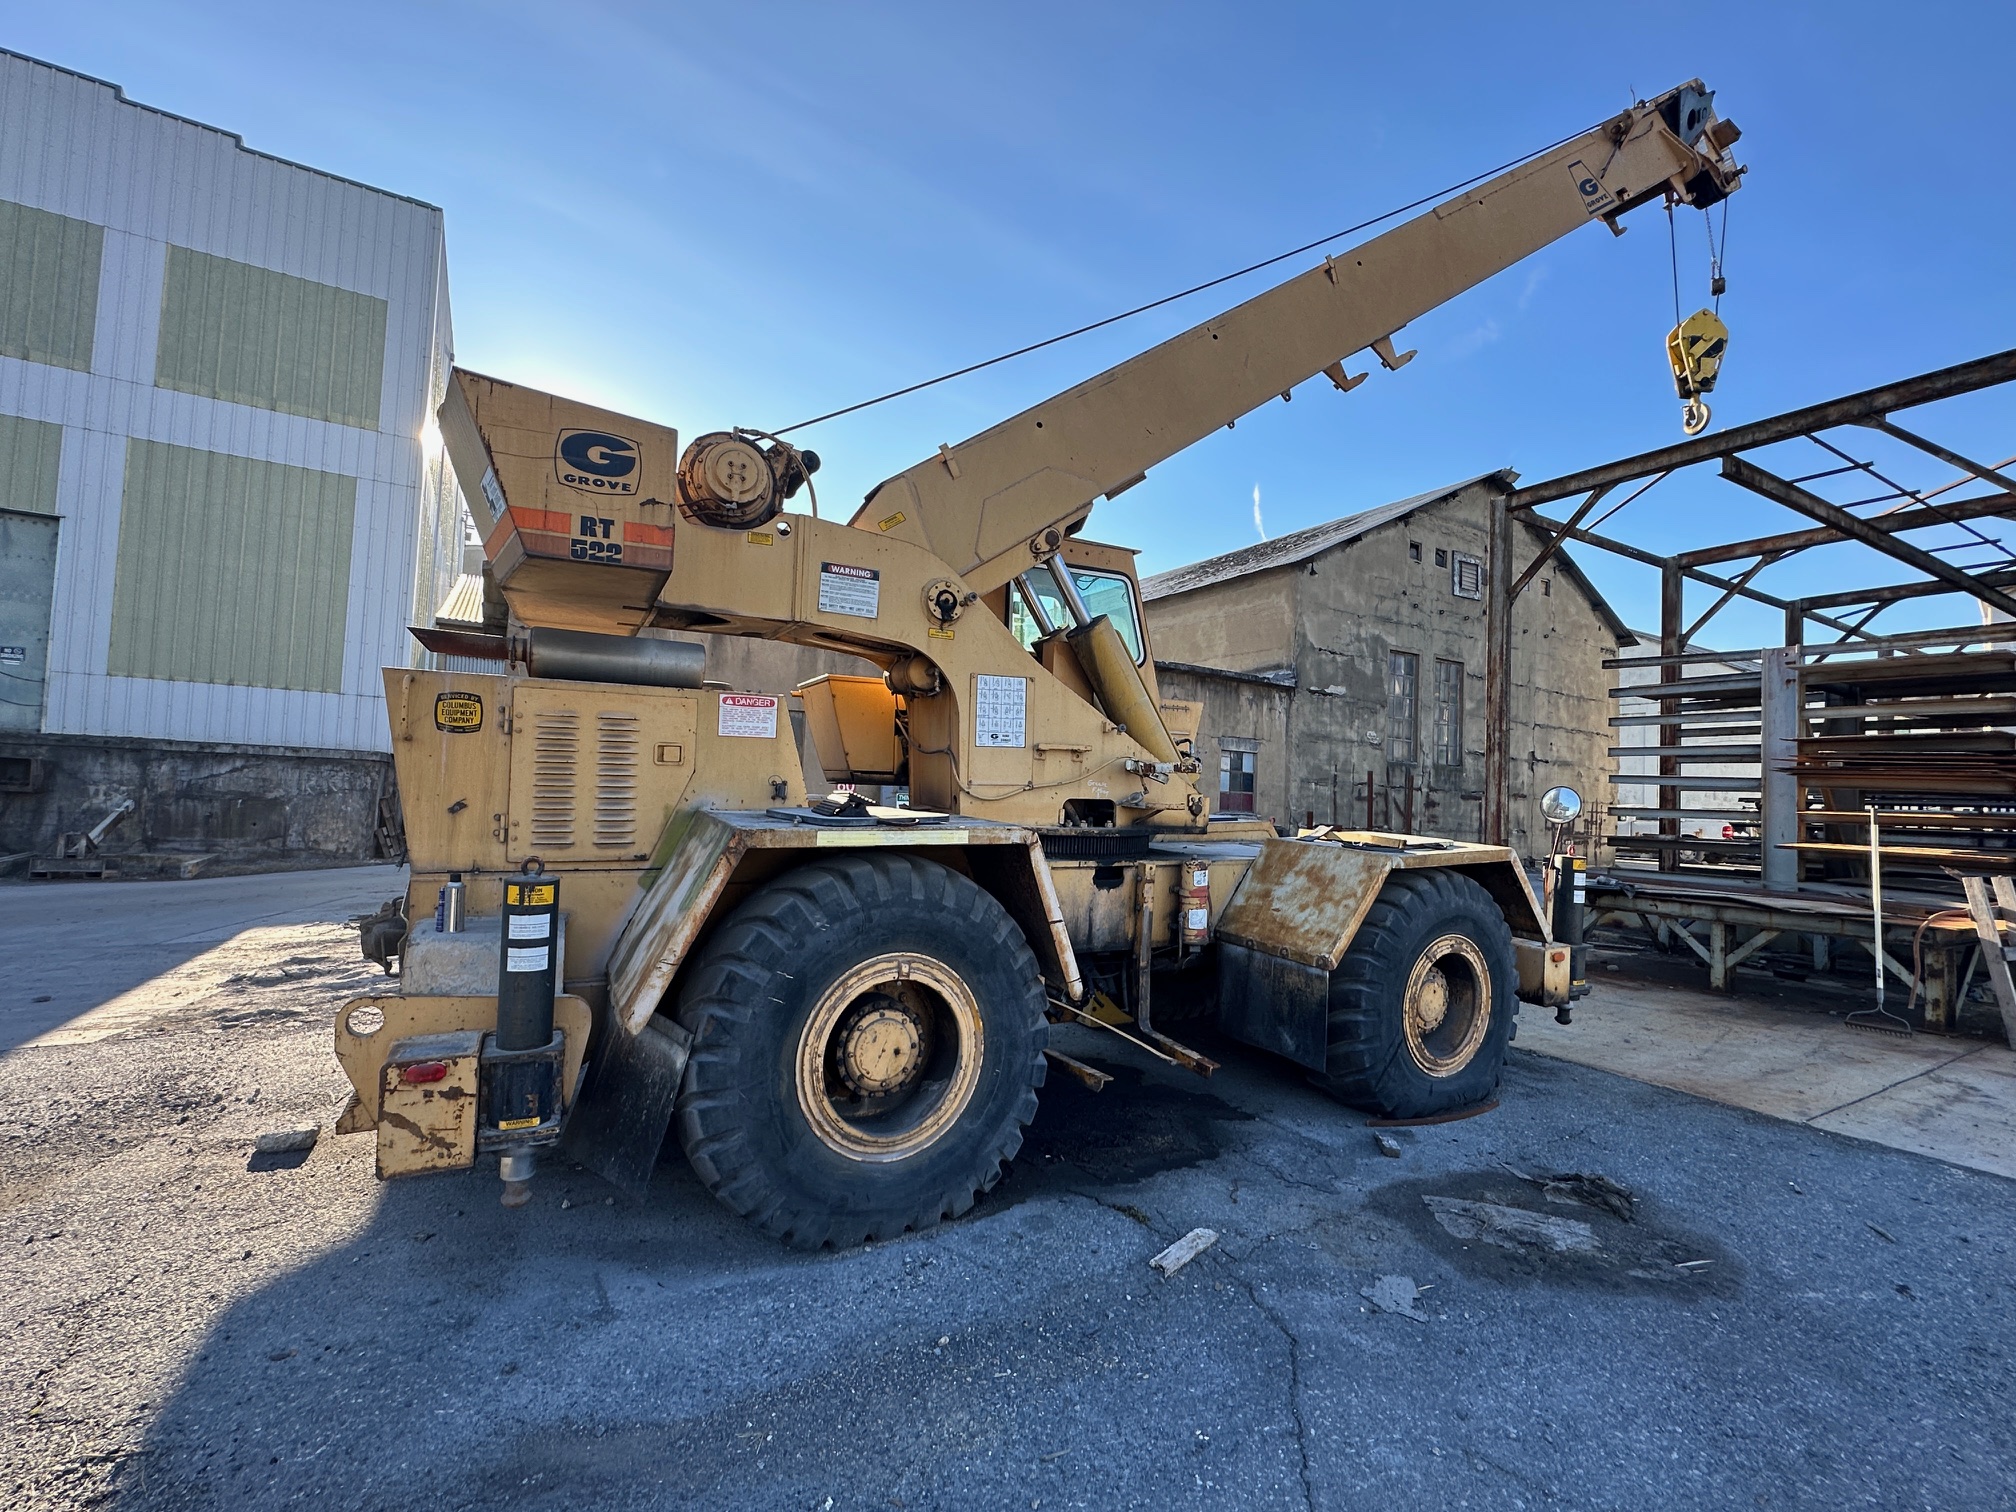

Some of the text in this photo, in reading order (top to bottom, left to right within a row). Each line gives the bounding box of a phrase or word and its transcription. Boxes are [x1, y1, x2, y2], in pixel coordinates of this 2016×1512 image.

[1579, 178, 1598, 196] G
[1586, 193, 1608, 207] GROVE
[560, 432, 637, 478] G
[563, 473, 632, 492] GROVE
[580, 515, 615, 539] RT
[571, 538, 623, 563] 522
[831, 565, 871, 578] WARNING
[442, 701, 476, 709] COLUMBUS
[735, 697, 771, 707] DANGER
[441, 709, 477, 717] EQUIPMENT
[444, 716, 475, 724] COMPANY
